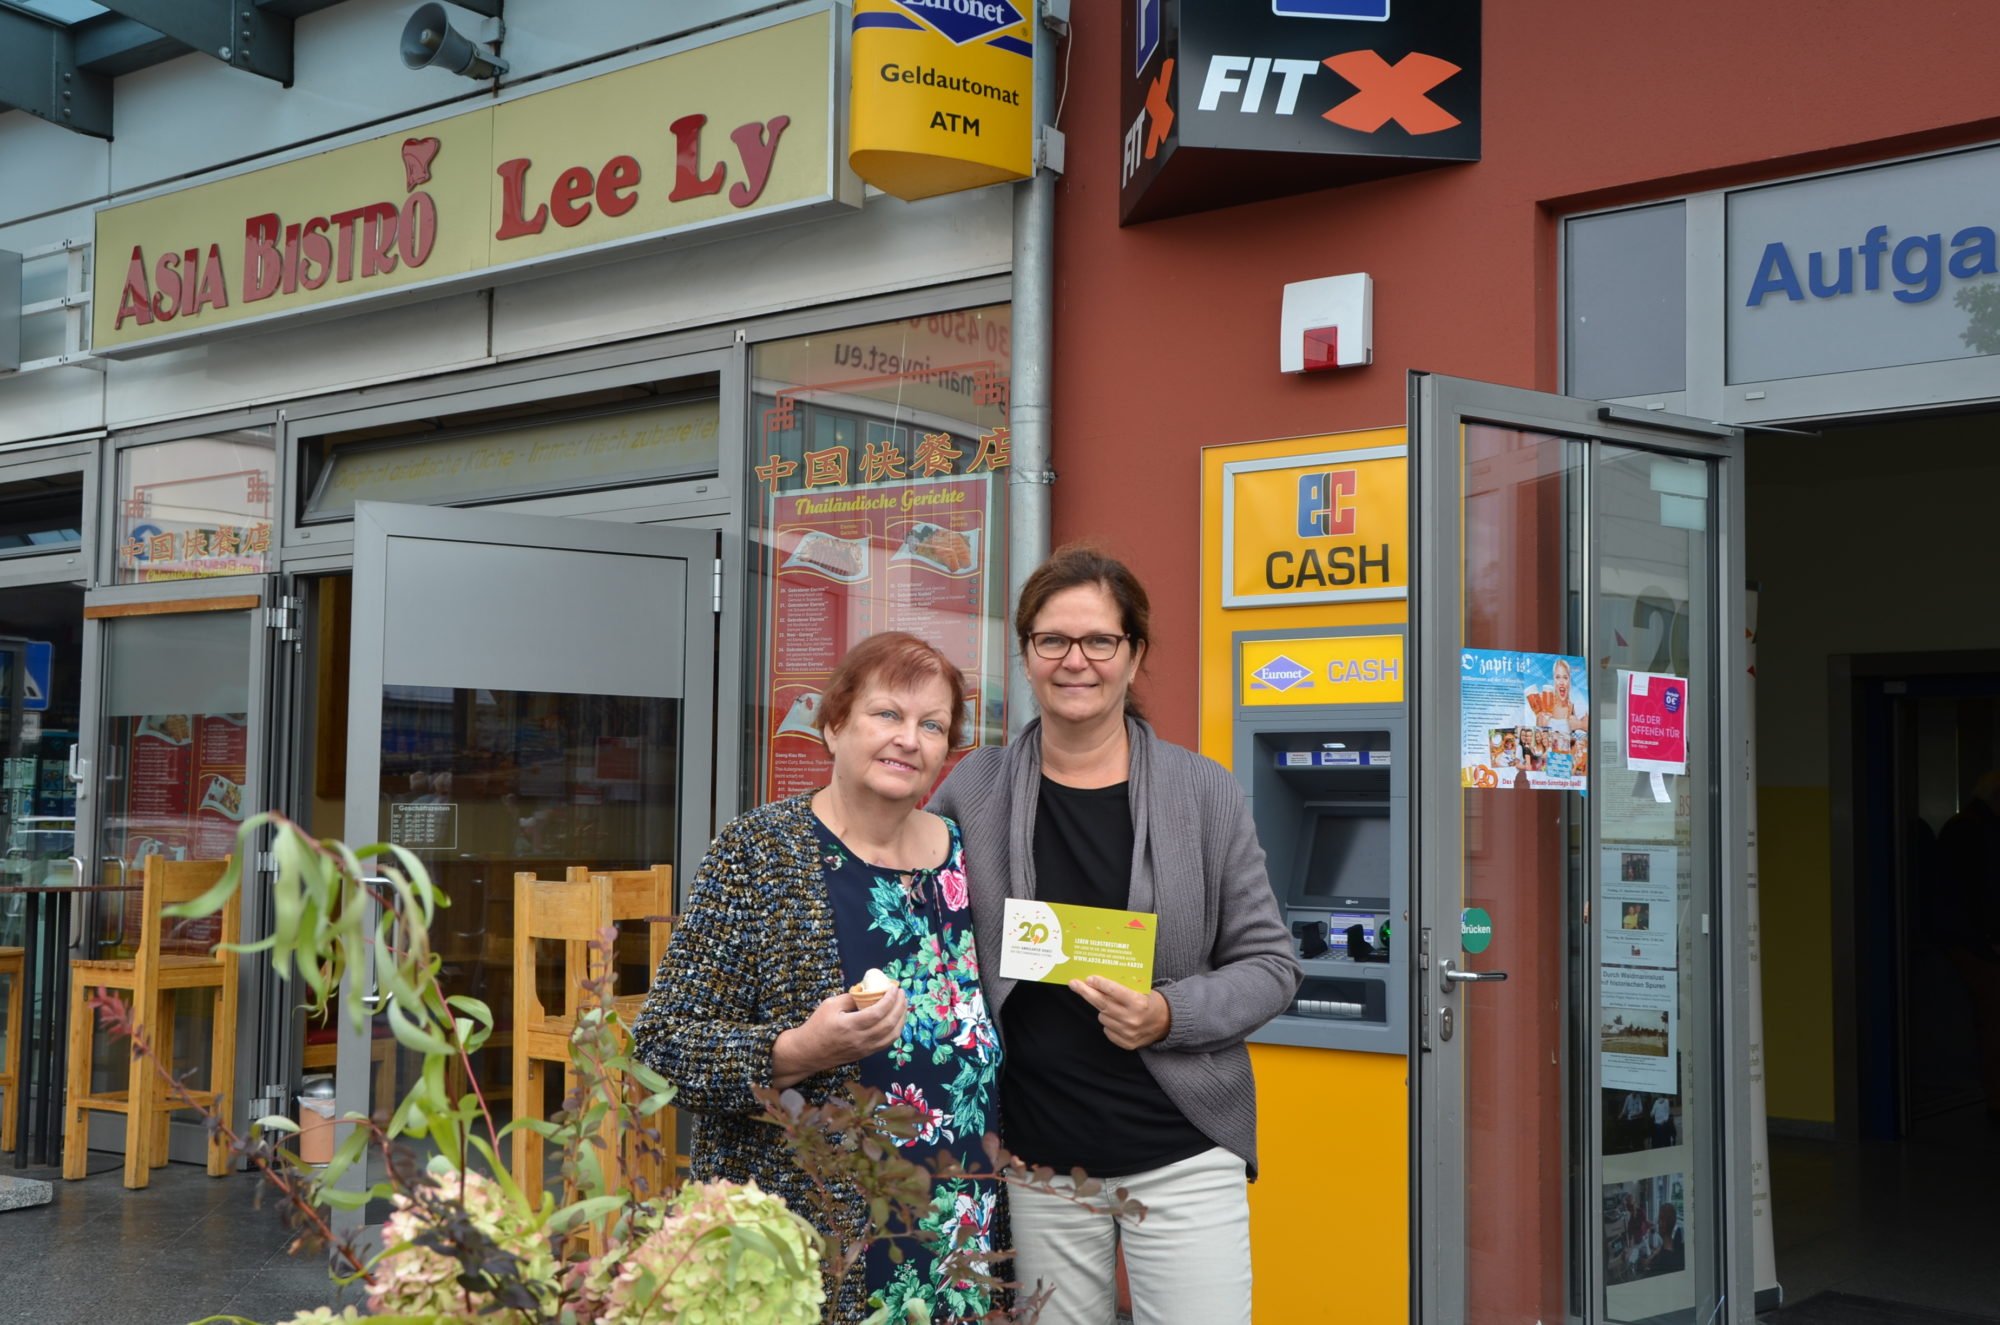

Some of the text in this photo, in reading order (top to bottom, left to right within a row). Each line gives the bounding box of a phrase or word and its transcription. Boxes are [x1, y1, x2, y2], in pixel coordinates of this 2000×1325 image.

[880, 63, 1020, 106] Geldautomat
[930, 111, 980, 137] ATM
[495, 155, 642, 242] Lee
[668, 113, 791, 209] Ly
[1746, 225, 1999, 307] Aufga
[794, 487, 965, 516] Thailändische Gerichte
[1265, 543, 1390, 590] CASH
[1261, 659, 1399, 683] Euronet CASH
[1631, 713, 1661, 725] TAG DER
[1631, 725, 1680, 738] OFFENEN TÜR
[1018, 921, 1049, 944] 20
